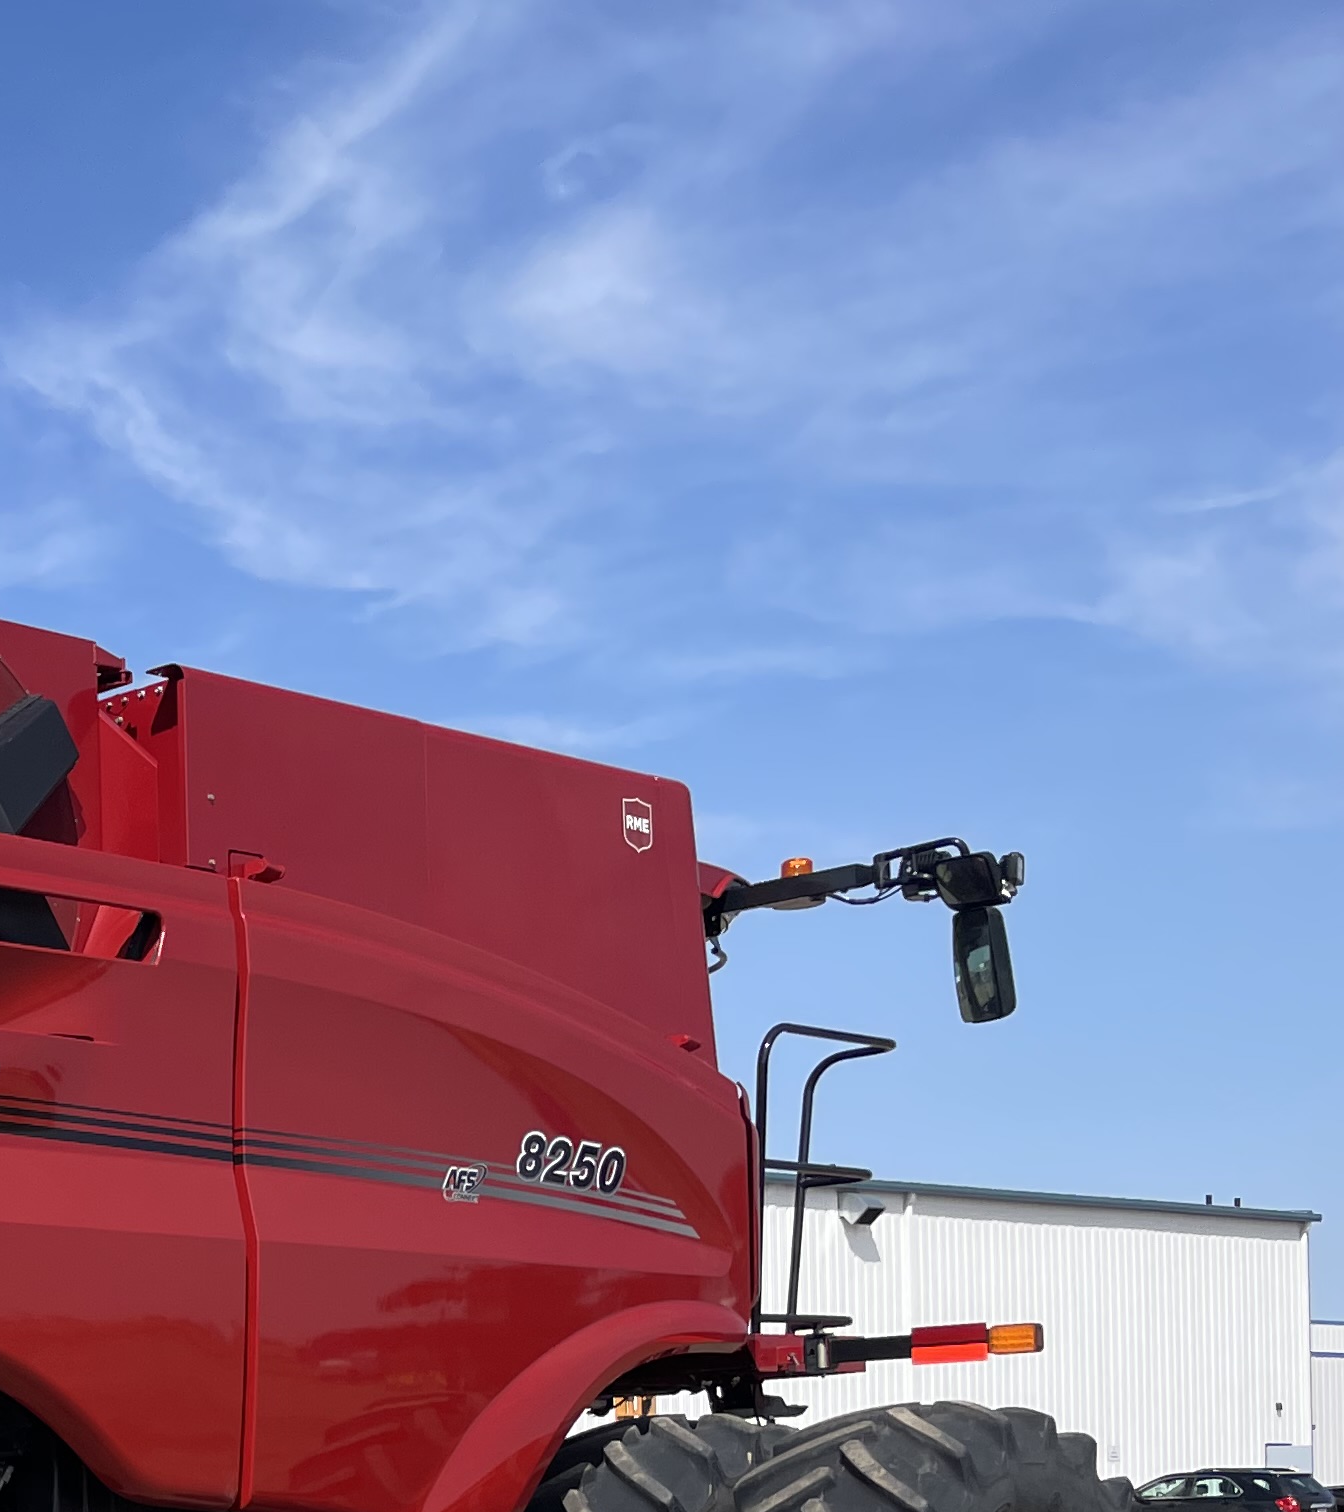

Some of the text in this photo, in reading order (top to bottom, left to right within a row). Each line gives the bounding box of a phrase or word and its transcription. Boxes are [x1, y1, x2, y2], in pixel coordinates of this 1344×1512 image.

[625, 814, 650, 835] RME
[516, 1130, 627, 1196] 8250
[442, 1165, 480, 1192] AFS
